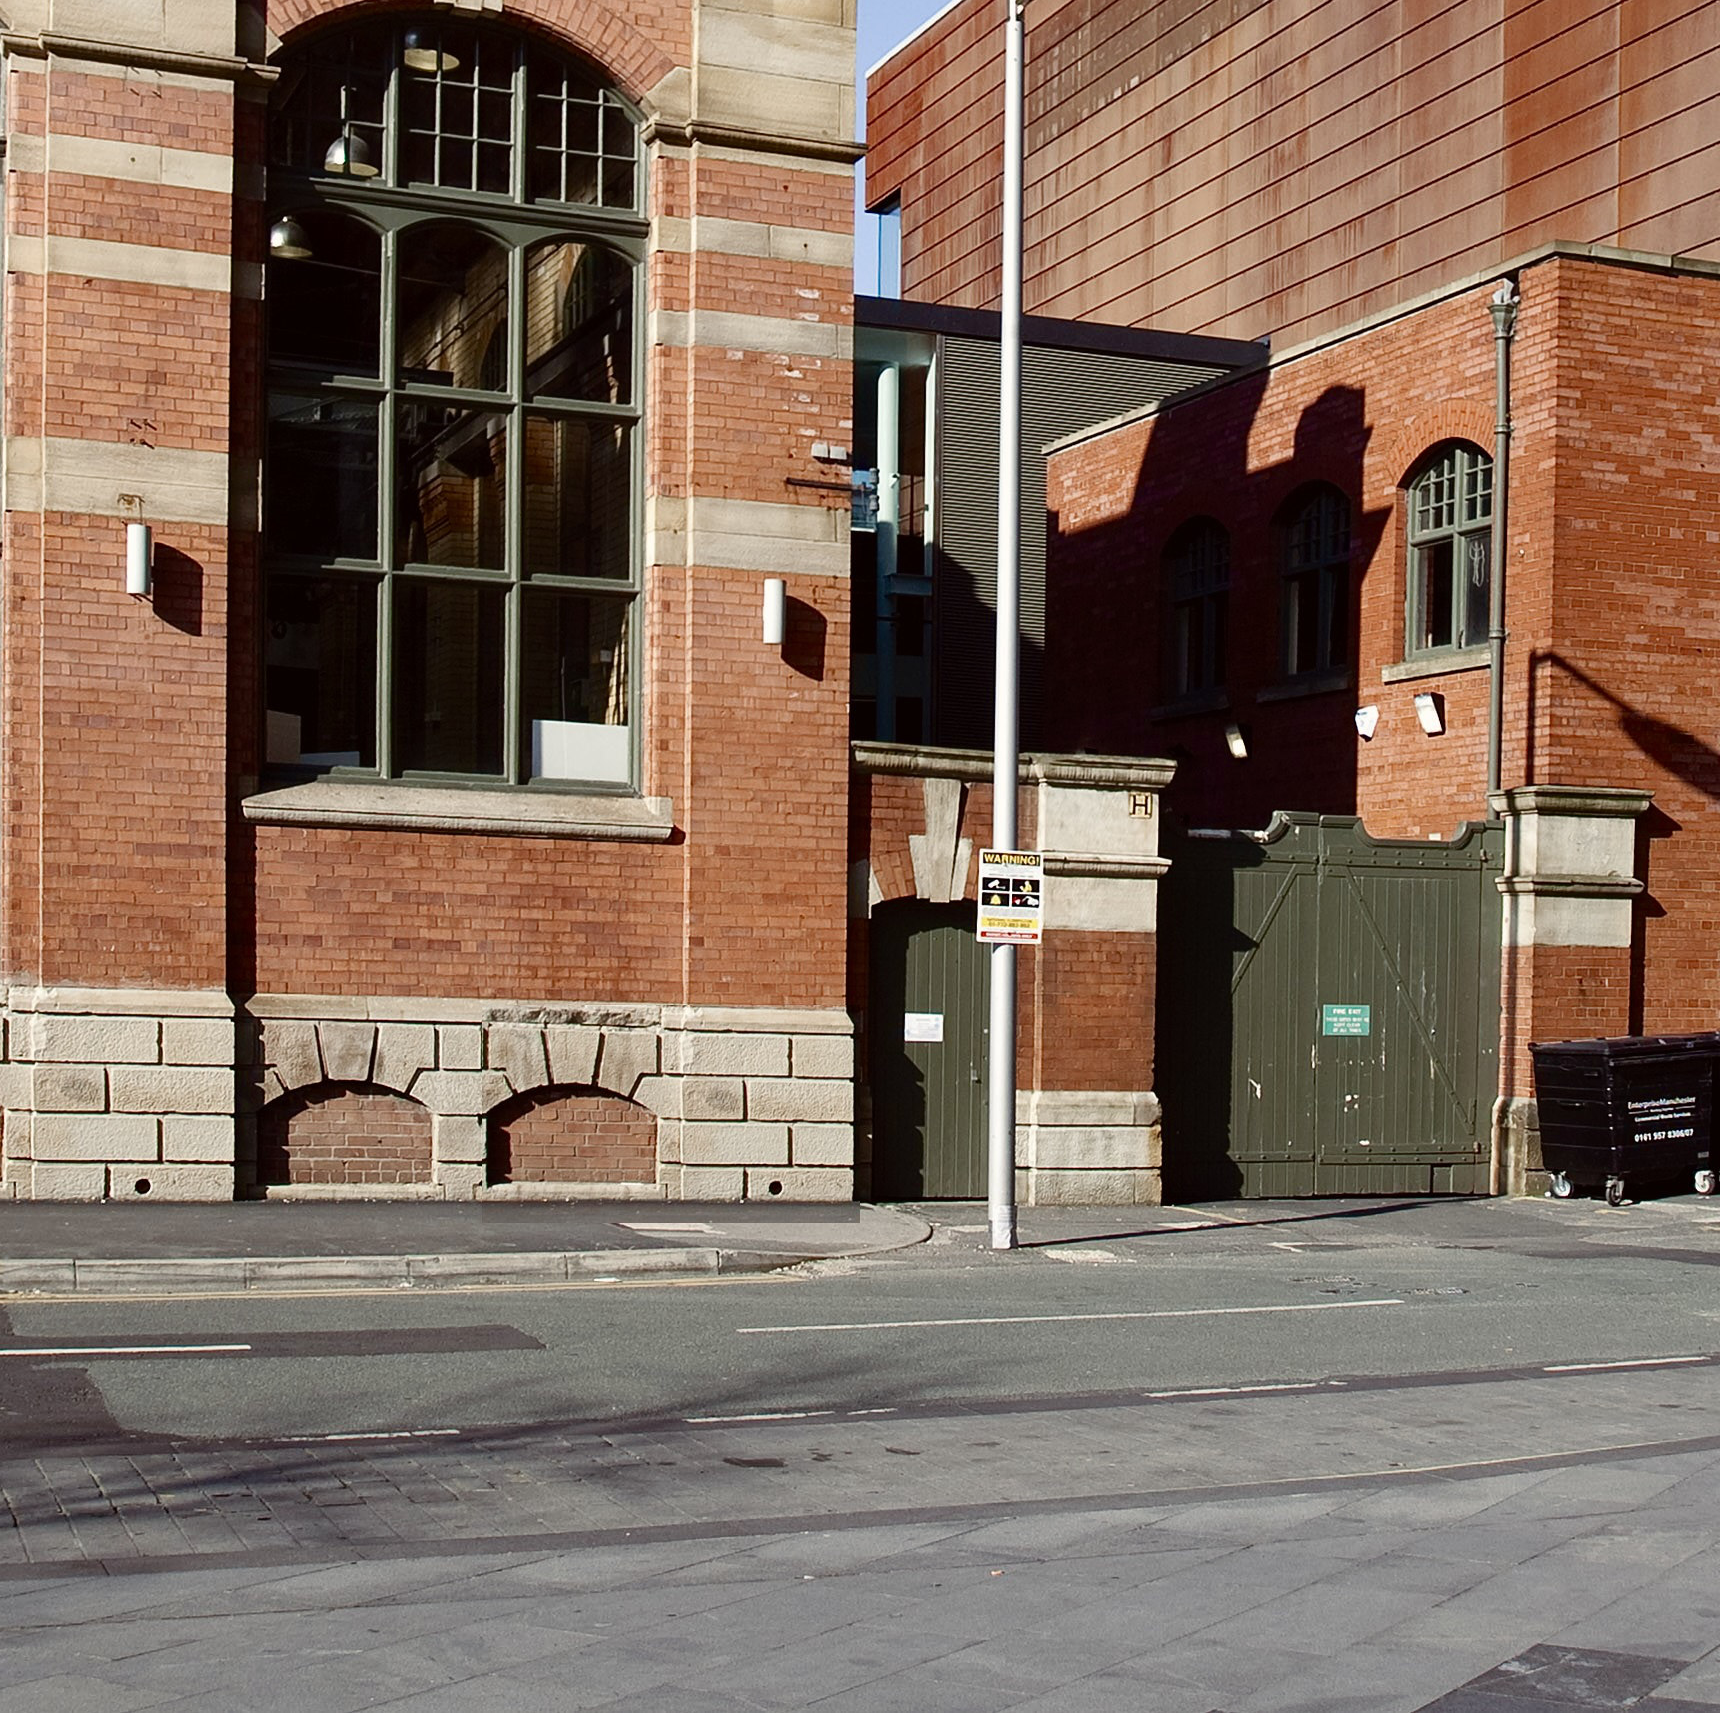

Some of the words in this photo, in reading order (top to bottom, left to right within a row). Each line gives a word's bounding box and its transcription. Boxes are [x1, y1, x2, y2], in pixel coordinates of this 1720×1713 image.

[1133, 794, 1148, 815] H
[984, 853, 1040, 866] WARNING!
[1634, 1133, 1652, 1143] 0161
[1653, 1131, 1666, 1140] 957
